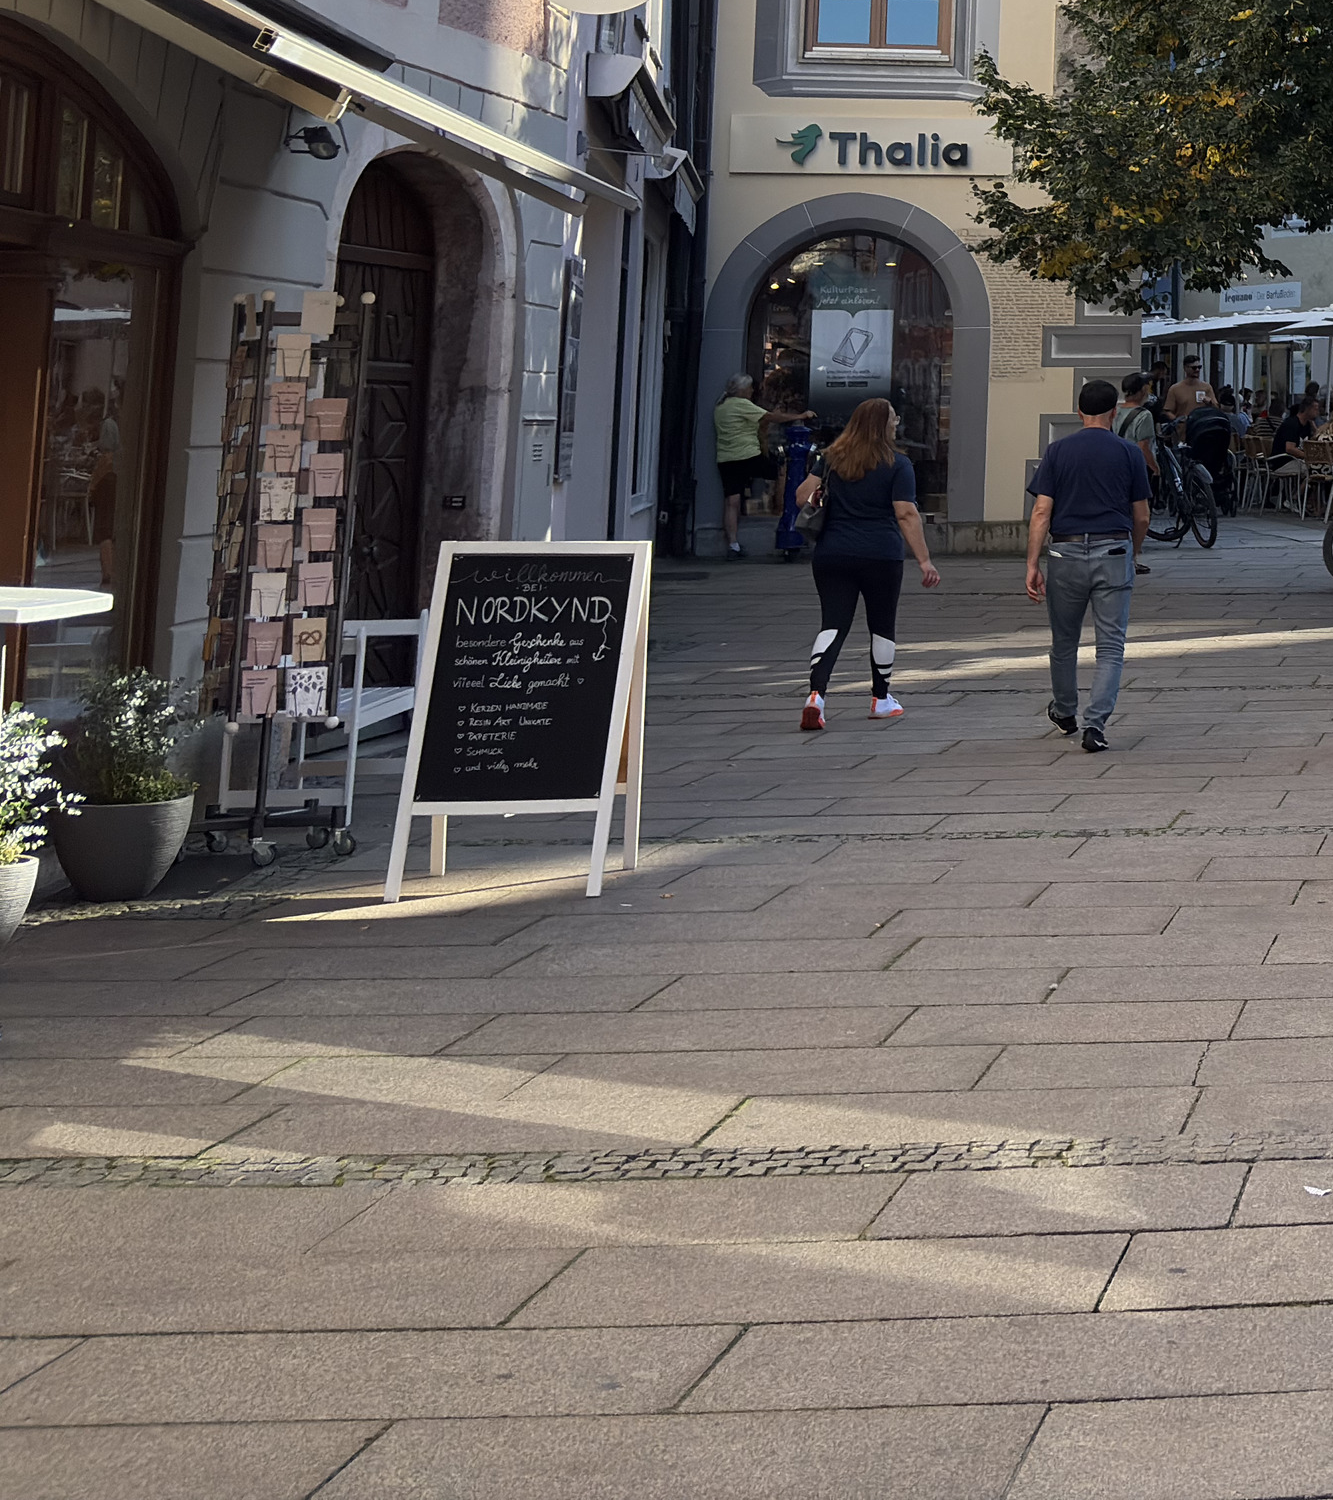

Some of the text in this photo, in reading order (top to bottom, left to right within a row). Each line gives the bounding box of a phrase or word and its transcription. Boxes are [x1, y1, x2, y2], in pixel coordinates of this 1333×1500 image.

[829, 132, 968, 167] Thalia
[456, 596, 612, 626] NORDKYND
[456, 632, 584, 653] besondere Geschenke aus
[454, 655, 488, 667] schönen
[488, 672, 522, 688] Liebe
